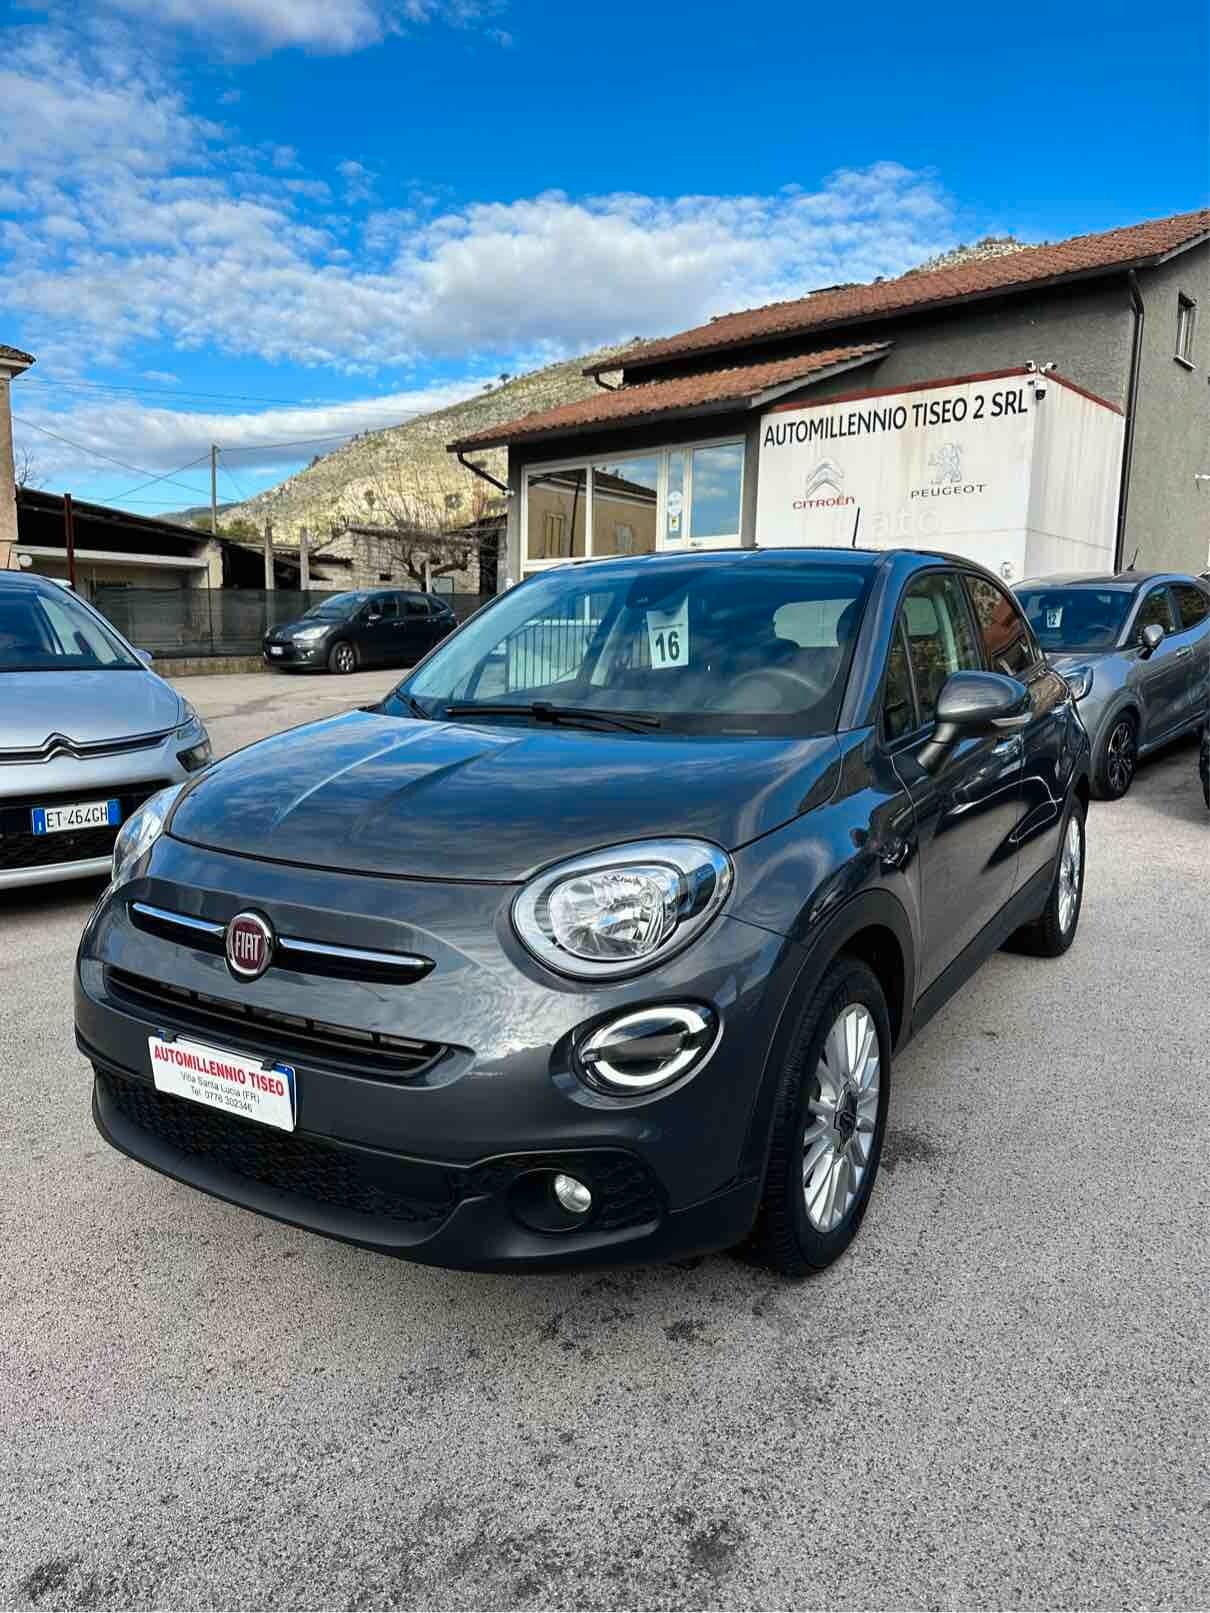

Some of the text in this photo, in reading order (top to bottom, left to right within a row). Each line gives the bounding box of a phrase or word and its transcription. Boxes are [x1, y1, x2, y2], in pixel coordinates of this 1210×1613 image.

[764, 389, 1028, 447] AUTOMILLENNIO TISEO 2 SRL
[911, 484, 985, 498] PEUGEOT
[656, 630, 680, 662] 16
[46, 807, 108, 828] ET 464GH
[235, 931, 261, 960] FIAT
[154, 1045, 285, 1096] AUTOMILLENNIO TISEO
[181, 1071, 196, 1083] Villa
[198, 1076, 220, 1091] Santa
[220, 1084, 240, 1097] Lucia
